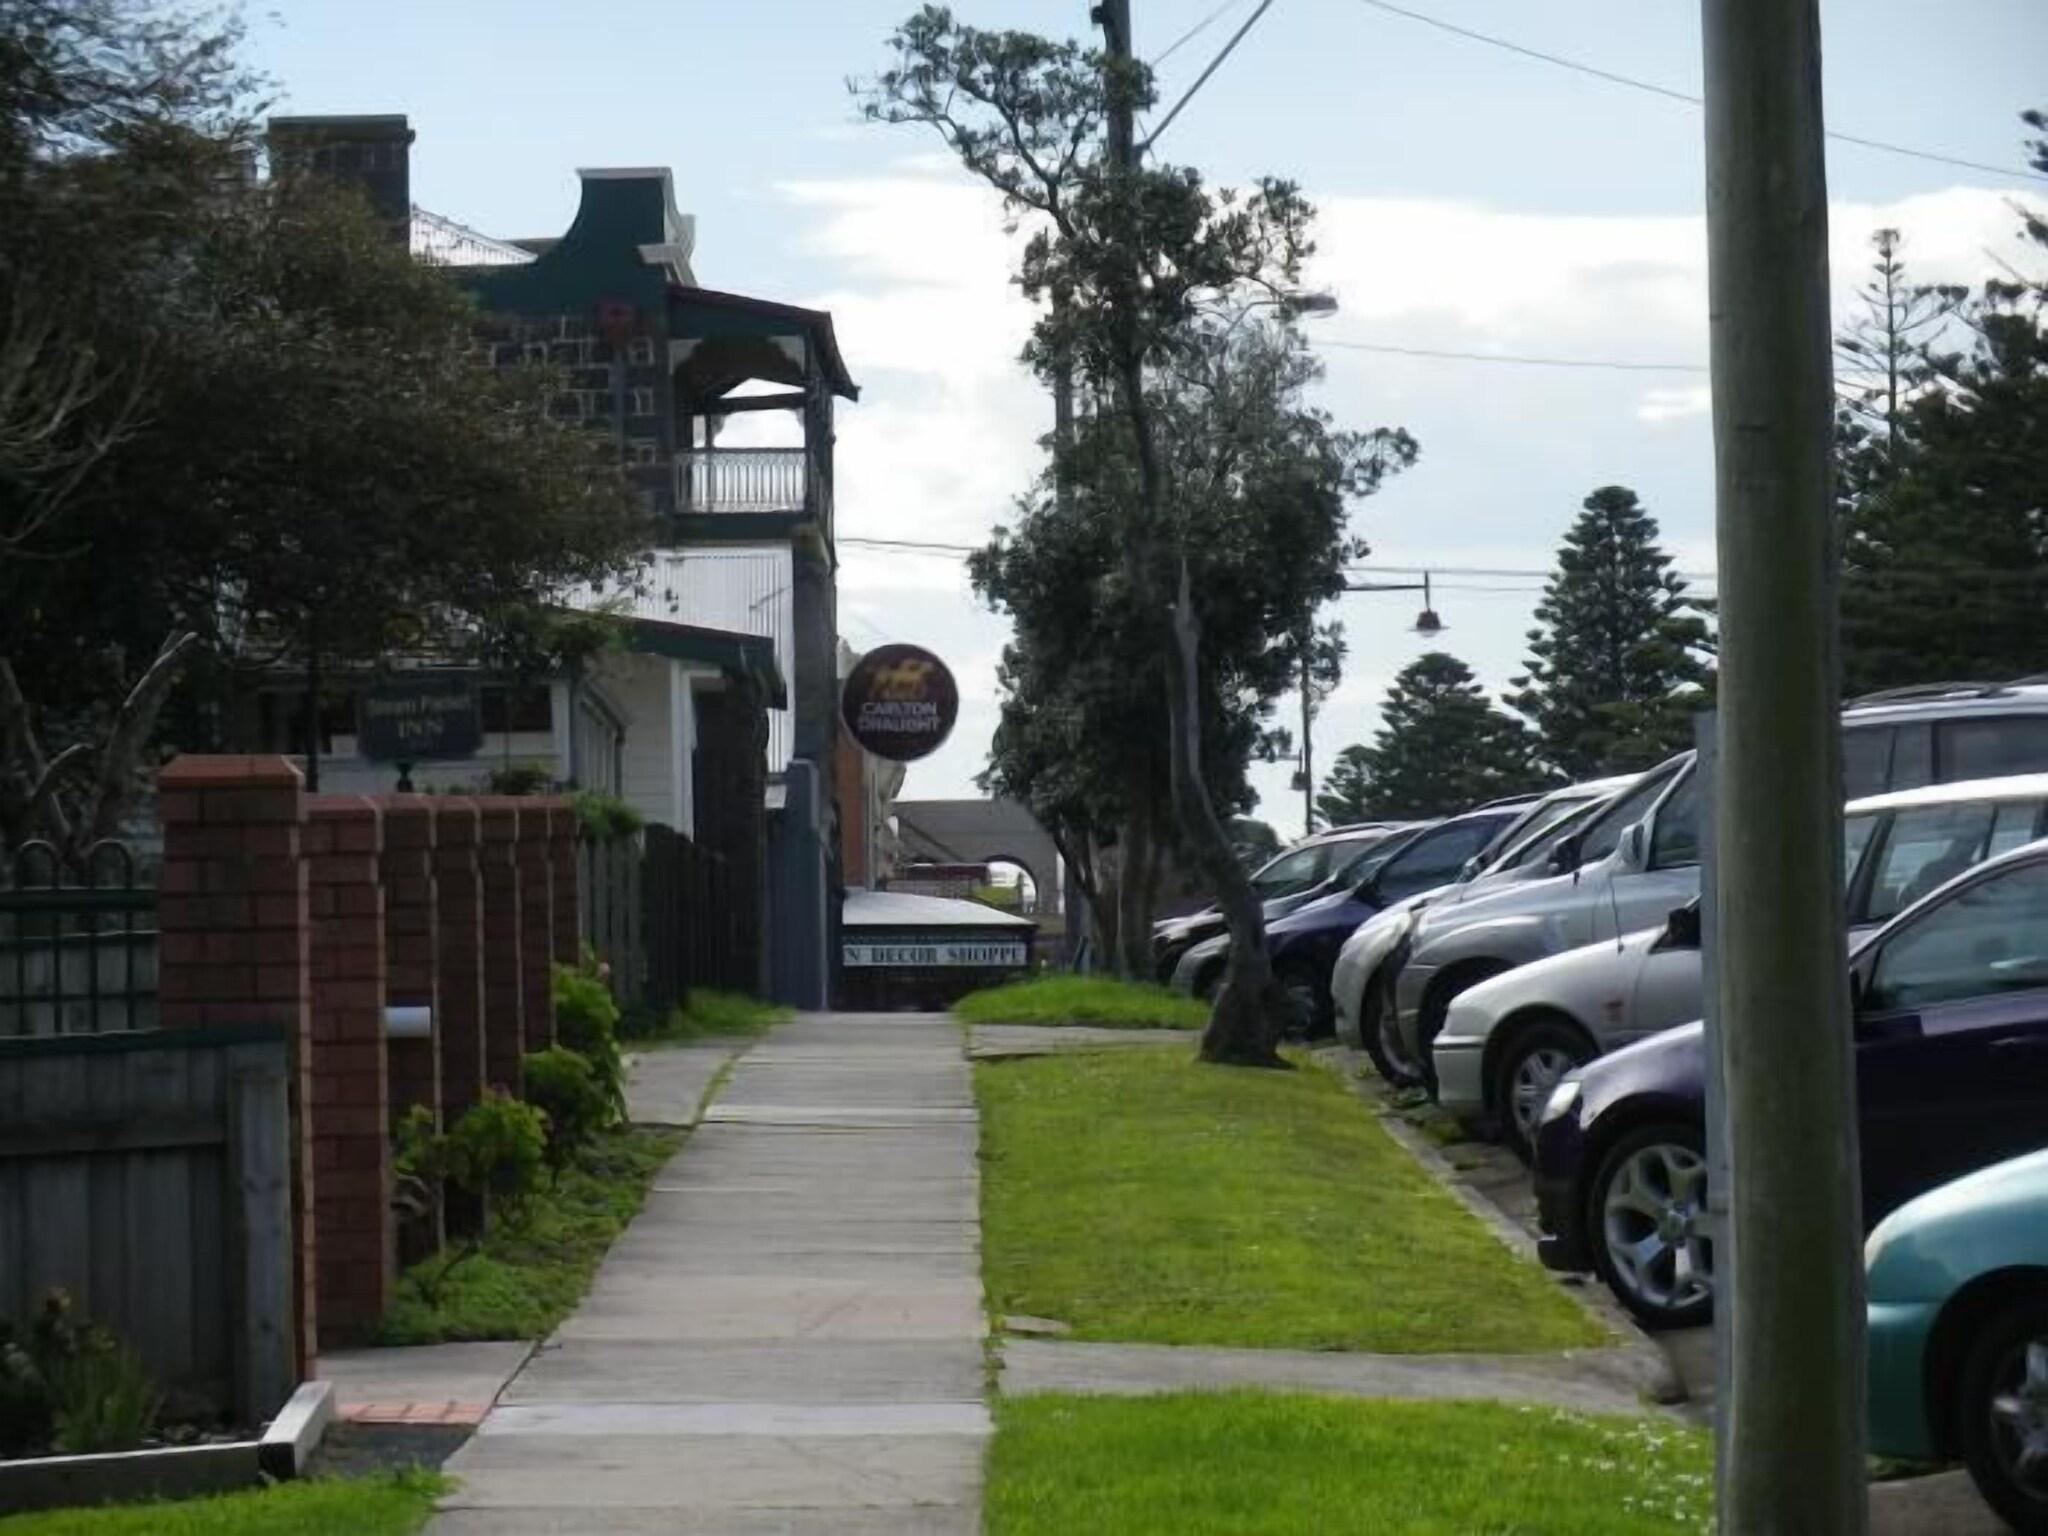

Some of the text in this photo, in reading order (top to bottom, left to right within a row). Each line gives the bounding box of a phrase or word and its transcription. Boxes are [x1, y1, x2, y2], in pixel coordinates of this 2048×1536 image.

[862, 701, 937, 715] CARLTON
[858, 714, 941, 732] DRAUGHT
[871, 946, 937, 962] DECOR
